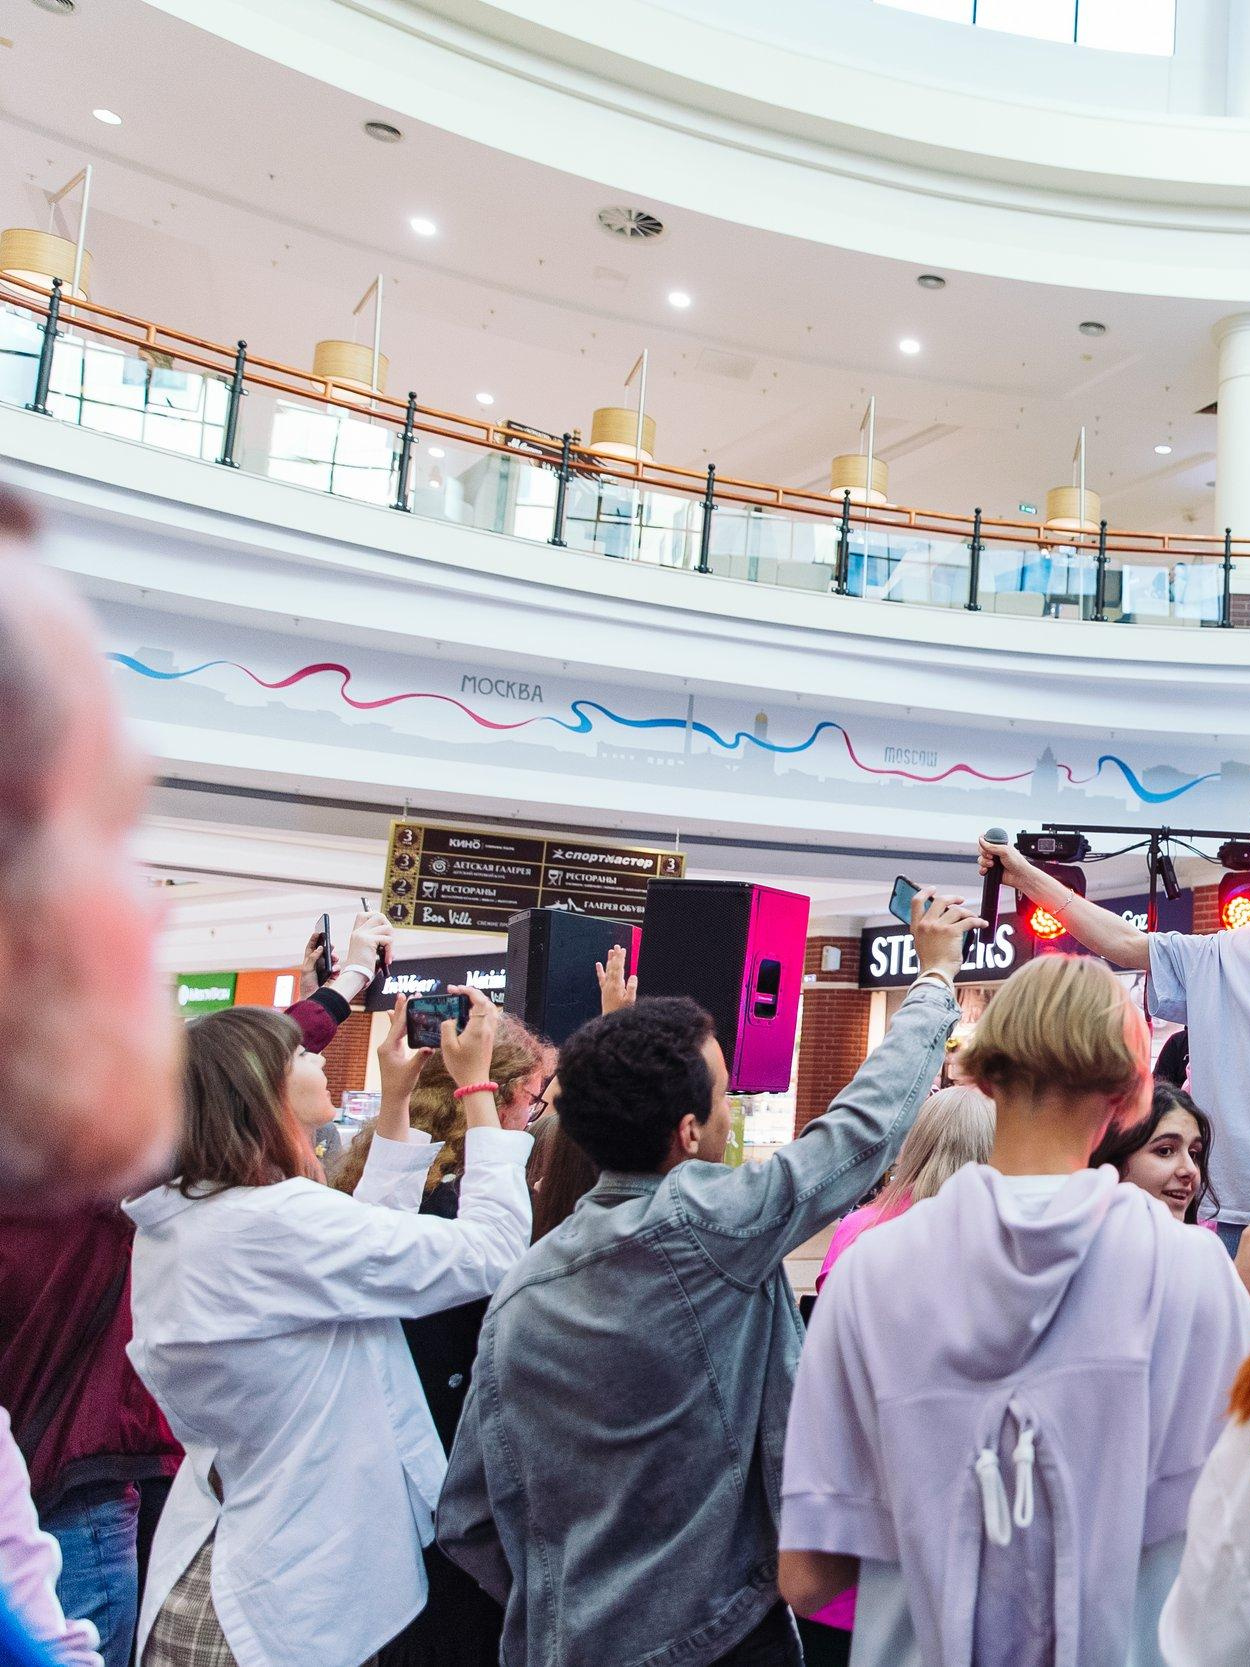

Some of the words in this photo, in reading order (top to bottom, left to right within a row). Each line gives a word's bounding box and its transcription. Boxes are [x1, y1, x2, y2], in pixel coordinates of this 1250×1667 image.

[461, 675, 543, 702] МОСКВА
[403, 829, 413, 842] 3
[400, 854, 410, 866] 3
[666, 858, 676, 869] 3
[453, 861, 494, 872] ДЕТСКАЯ
[495, 864, 532, 876] ГАЛЕРЕЯ
[566, 872, 617, 884] РЕСТОРАНЫ
[397, 879, 407, 891] 2
[441, 884, 496, 897] РЕСТОРАНЫ
[395, 905, 402, 916] 1
[584, 901, 619, 911] ГАЛЕРЕЯ
[423, 907, 446, 923] Bon
[449, 909, 472, 926] Ville
